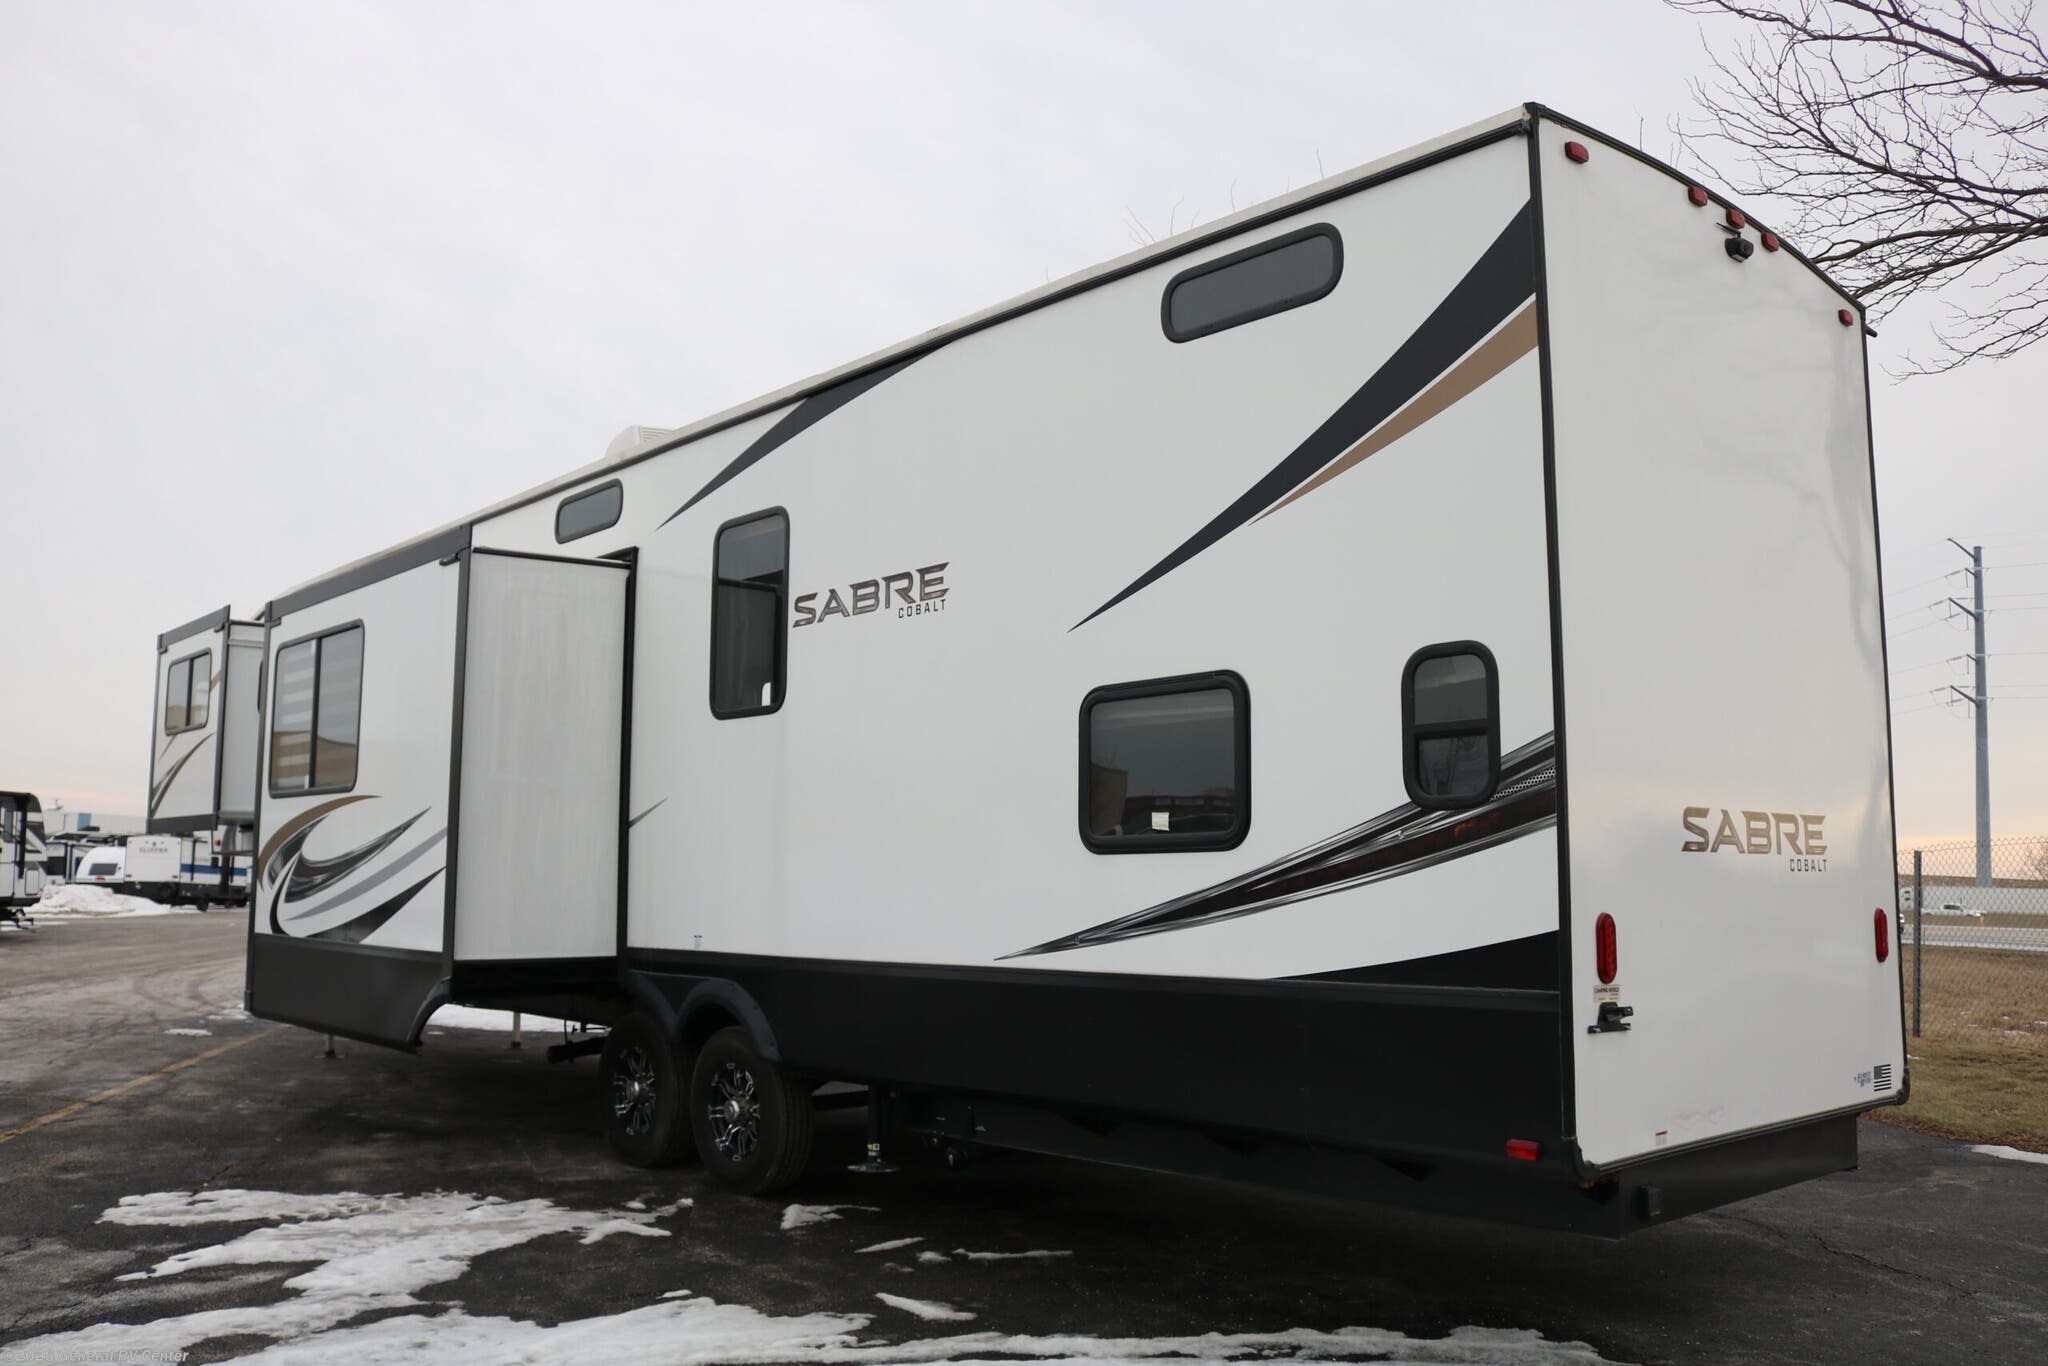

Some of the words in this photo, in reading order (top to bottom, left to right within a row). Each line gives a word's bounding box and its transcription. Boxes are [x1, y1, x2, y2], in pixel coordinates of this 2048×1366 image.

[792, 561, 950, 628] SABRE
[898, 599, 946, 619] COBALT
[1681, 806, 1828, 856] SABRE
[1789, 858, 1827, 872] COBALT
